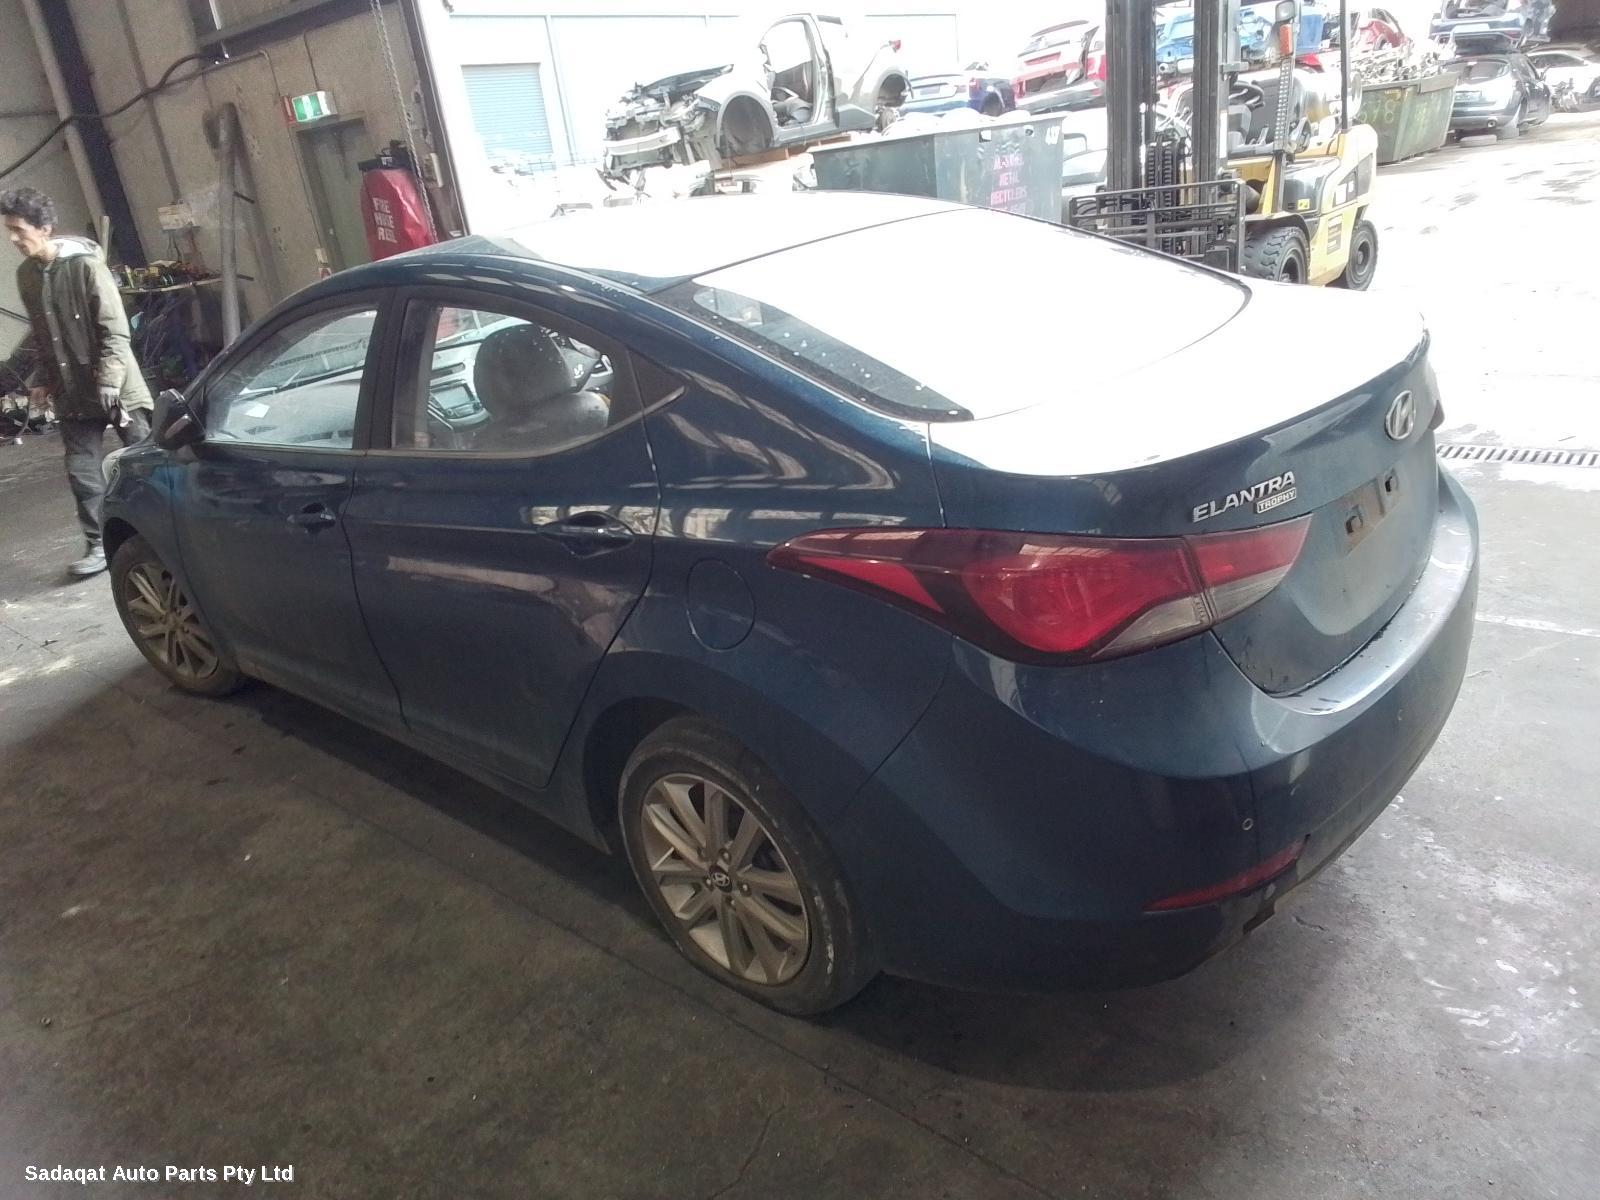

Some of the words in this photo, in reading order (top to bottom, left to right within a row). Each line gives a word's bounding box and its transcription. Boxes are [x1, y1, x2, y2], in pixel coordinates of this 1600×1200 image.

[372, 197, 391, 214] FIRE
[374, 211, 396, 229] HOSE
[377, 226, 398, 244] REEL
[1193, 470, 1296, 523] ELANTRA
[1259, 489, 1296, 511] TROPHY
